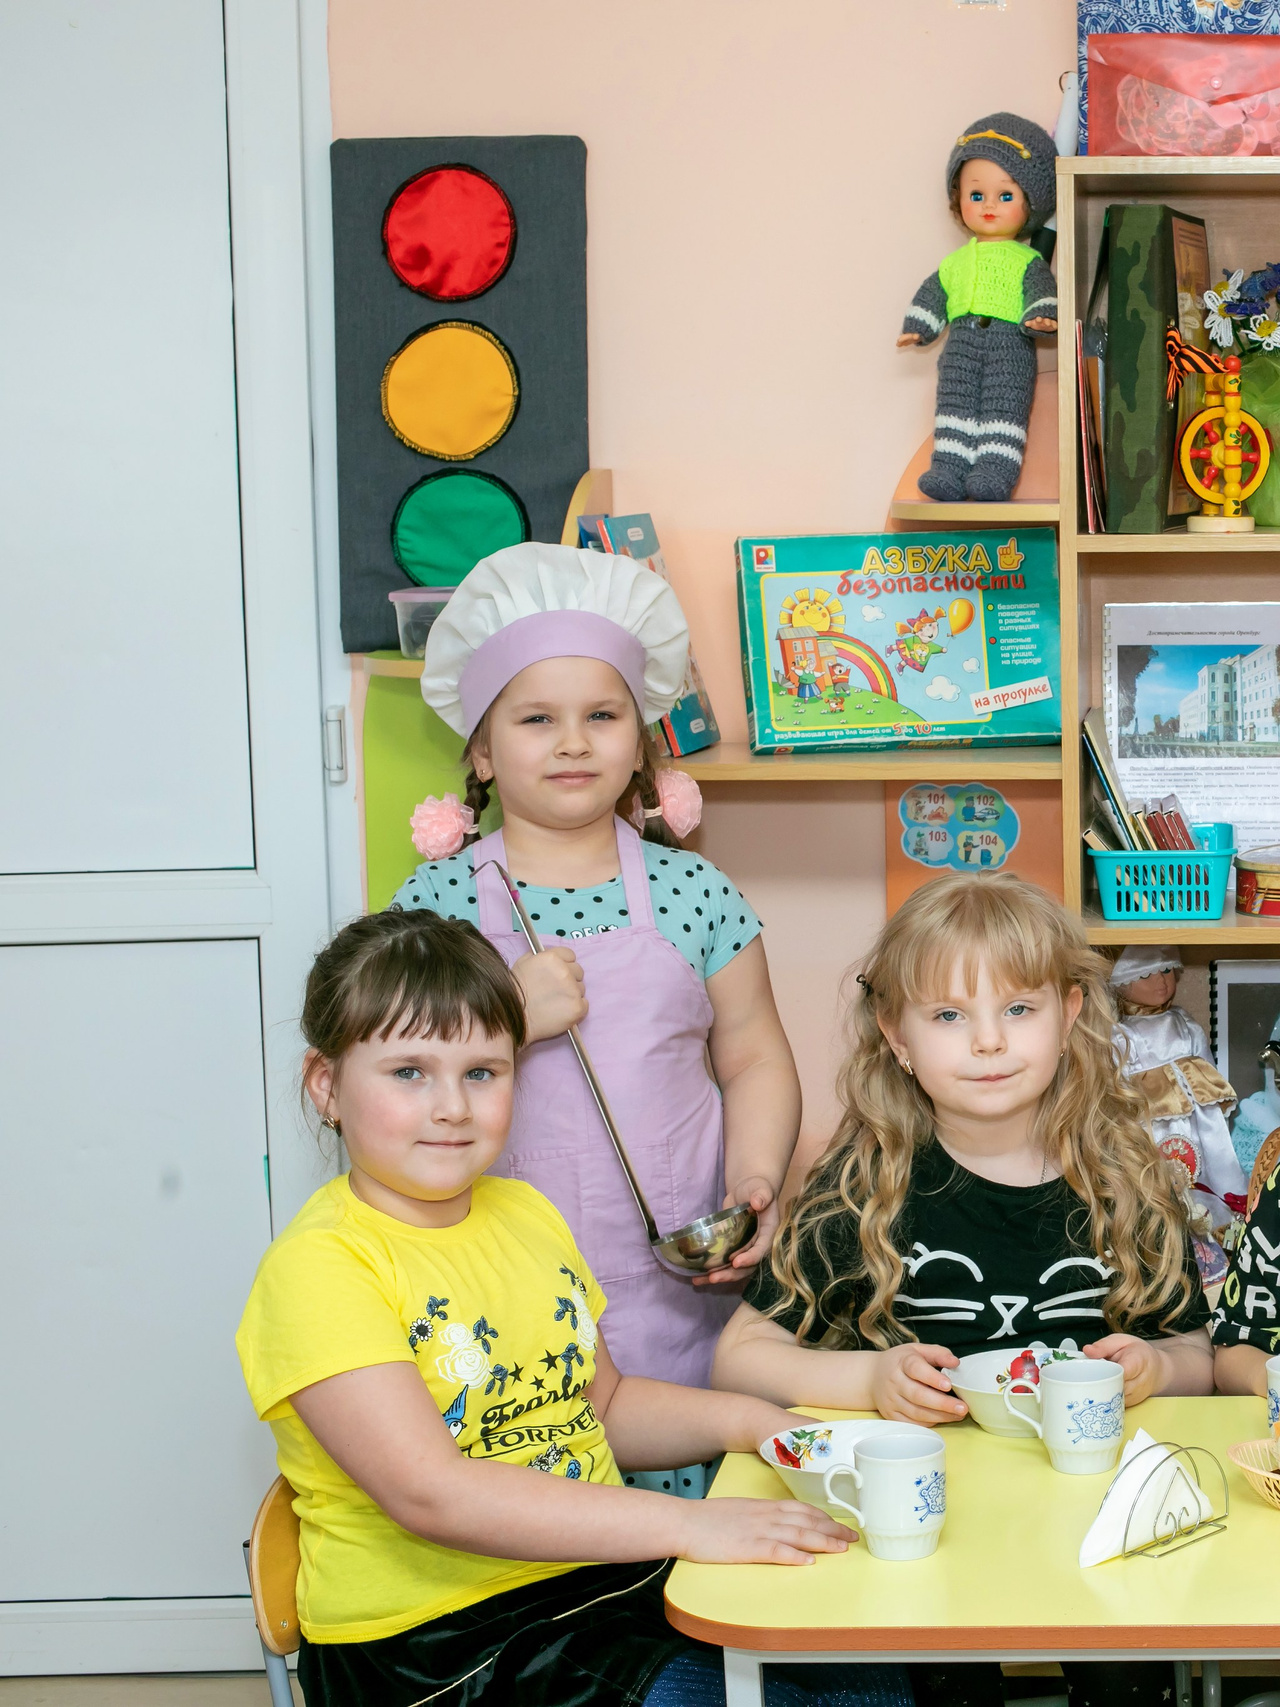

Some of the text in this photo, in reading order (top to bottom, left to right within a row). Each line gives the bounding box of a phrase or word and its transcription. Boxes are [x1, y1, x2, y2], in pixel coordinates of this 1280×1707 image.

[861, 543, 993, 577] АЗБУКА
[836, 570, 1025, 599] безопасности
[974, 683, 1049, 708] на прогулке
[892, 723, 902, 735] 5
[913, 723, 932, 734] 10
[927, 793, 946, 805] 101
[976, 795, 995, 806] 102
[928, 830, 948, 842] 103
[979, 834, 998, 846] 104
